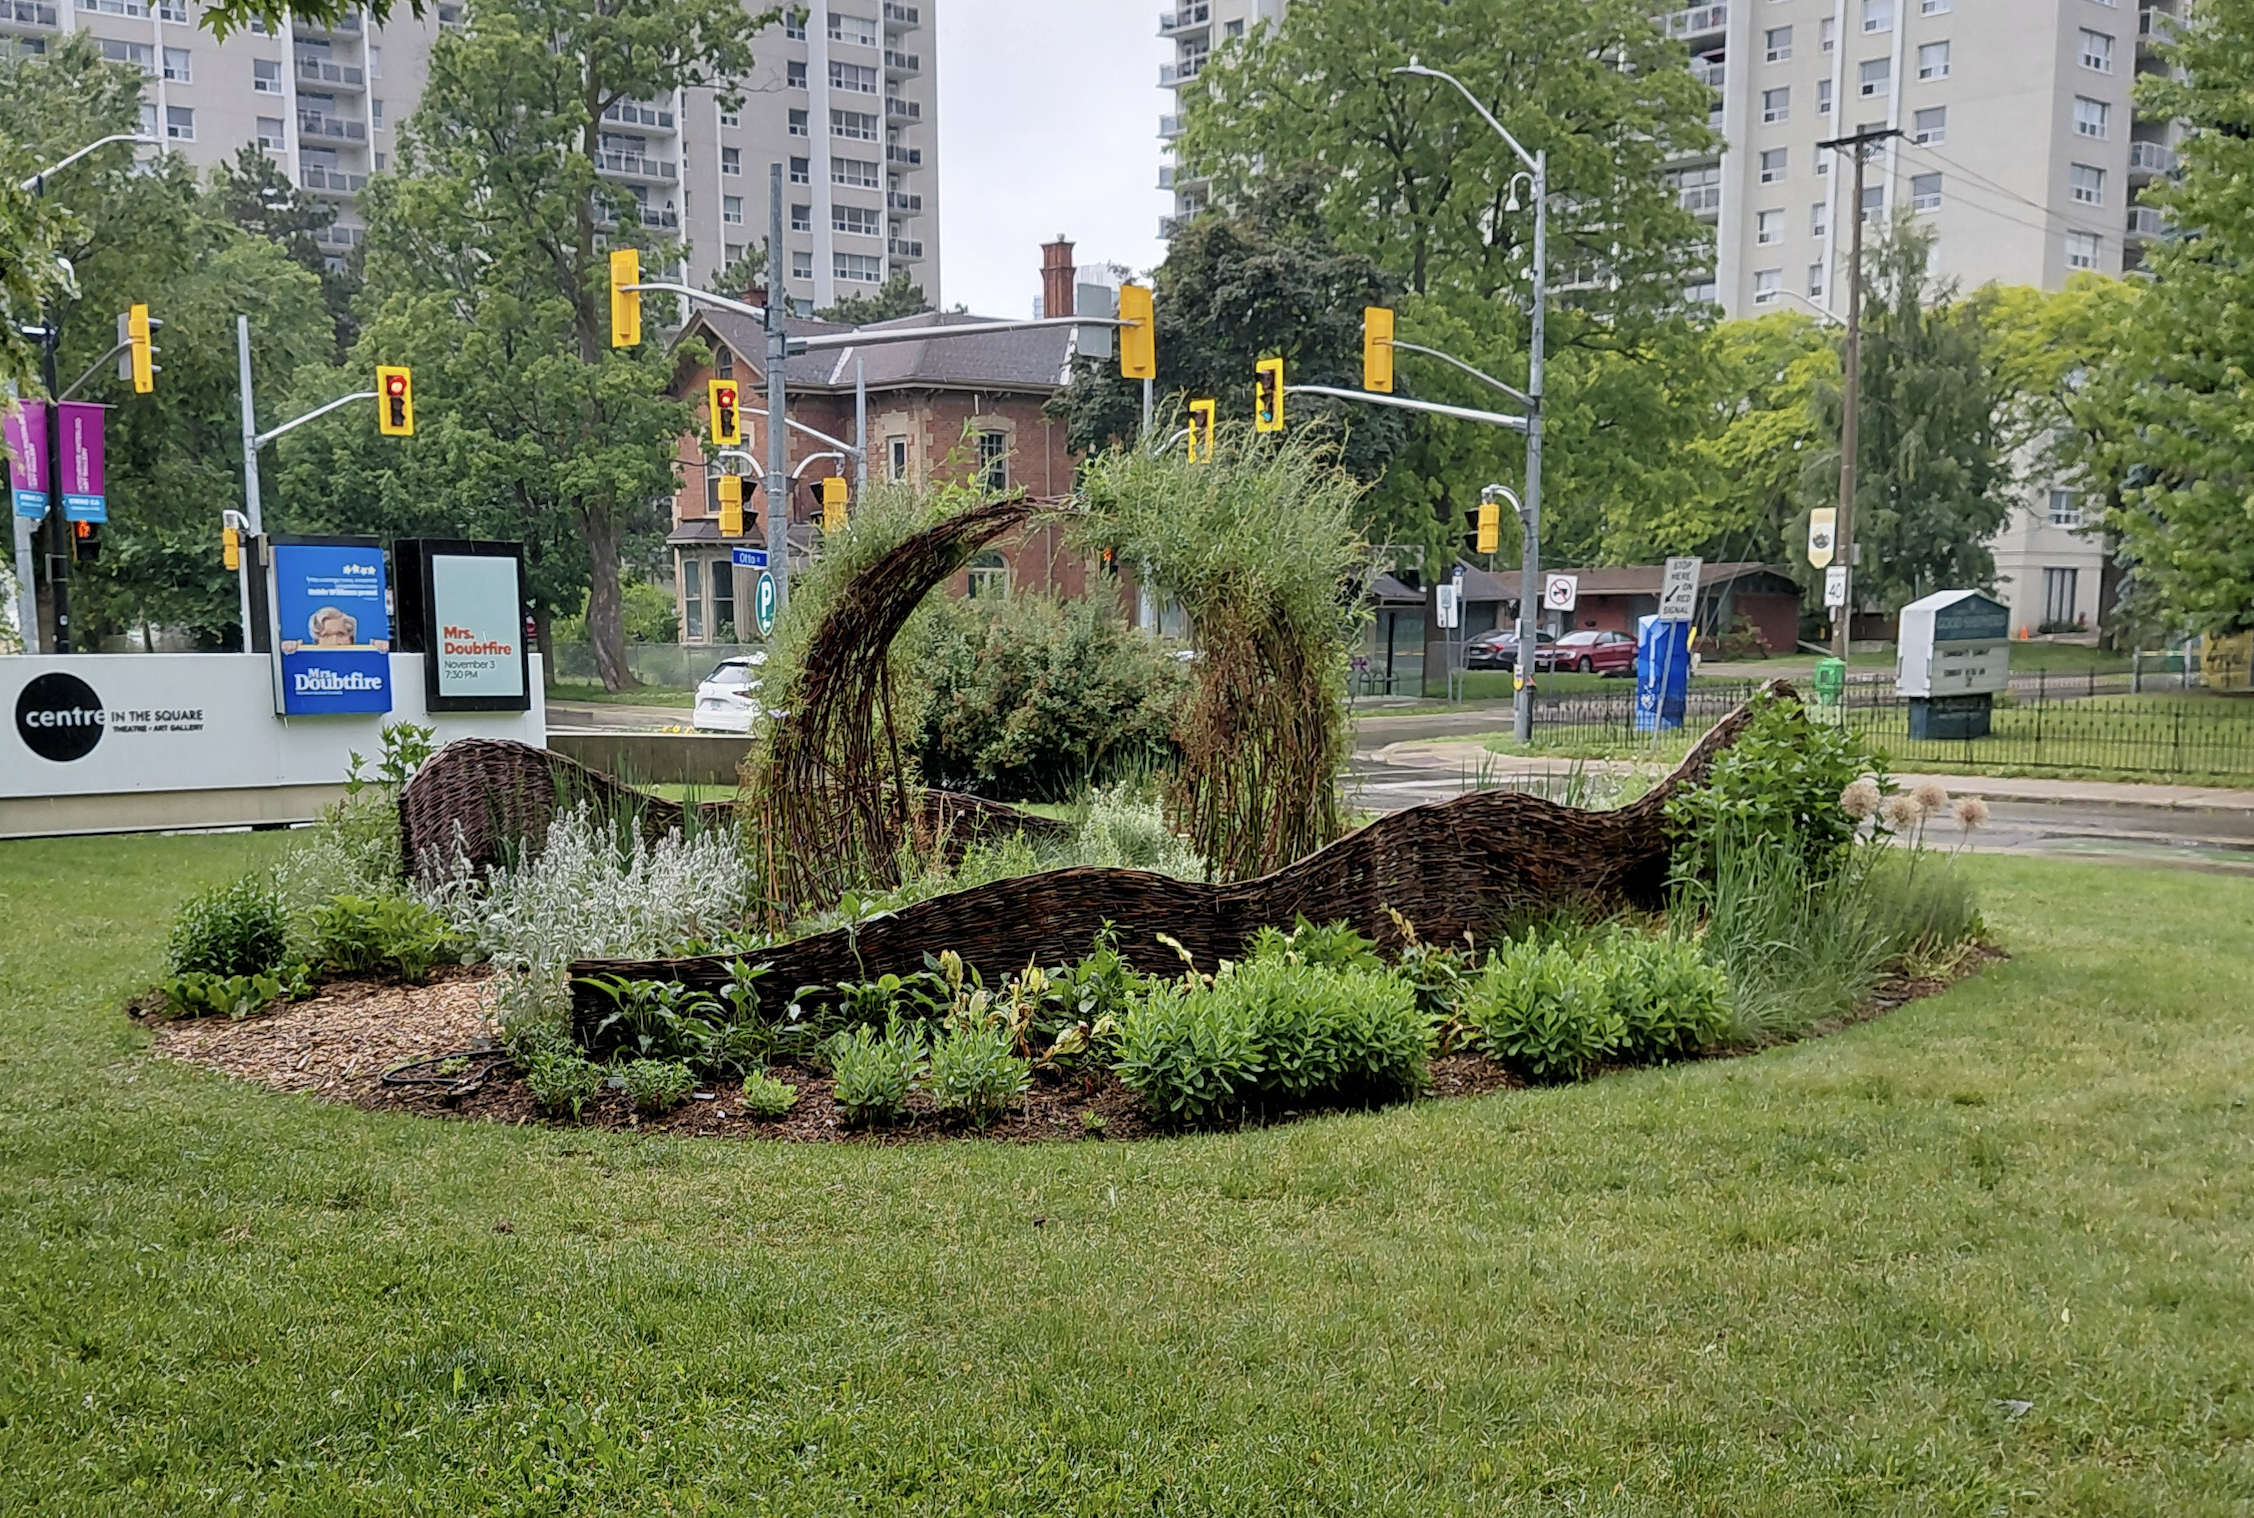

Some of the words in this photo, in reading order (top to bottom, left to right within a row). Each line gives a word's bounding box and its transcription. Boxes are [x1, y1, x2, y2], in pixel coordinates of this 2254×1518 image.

[740, 552, 756, 564] Otto
[1673, 561, 1693, 570] STOP
[1672, 572, 1691, 581] HERE
[1682, 583, 1693, 591] ON
[1828, 583, 1843, 599] 40
[761, 581, 773, 618] P
[1676, 595, 1692, 603] RED
[1663, 606, 1689, 615] SIGNAL
[443, 626, 475, 639] Mrs.
[444, 641, 512, 655] Doubtfire
[444, 660, 488, 669] November
[490, 660, 496, 669] 3
[445, 670, 463, 679] 7:30
[465, 670, 478, 679] PM
[294, 671, 382, 690] Doubtfire
[25, 706, 105, 728] centre
[111, 711, 126, 722] IN
[129, 710, 151, 722] THE
[154, 709, 204, 721] SQUARE
[153, 724, 168, 732] ART
[170, 723, 204, 732] GALLERY
